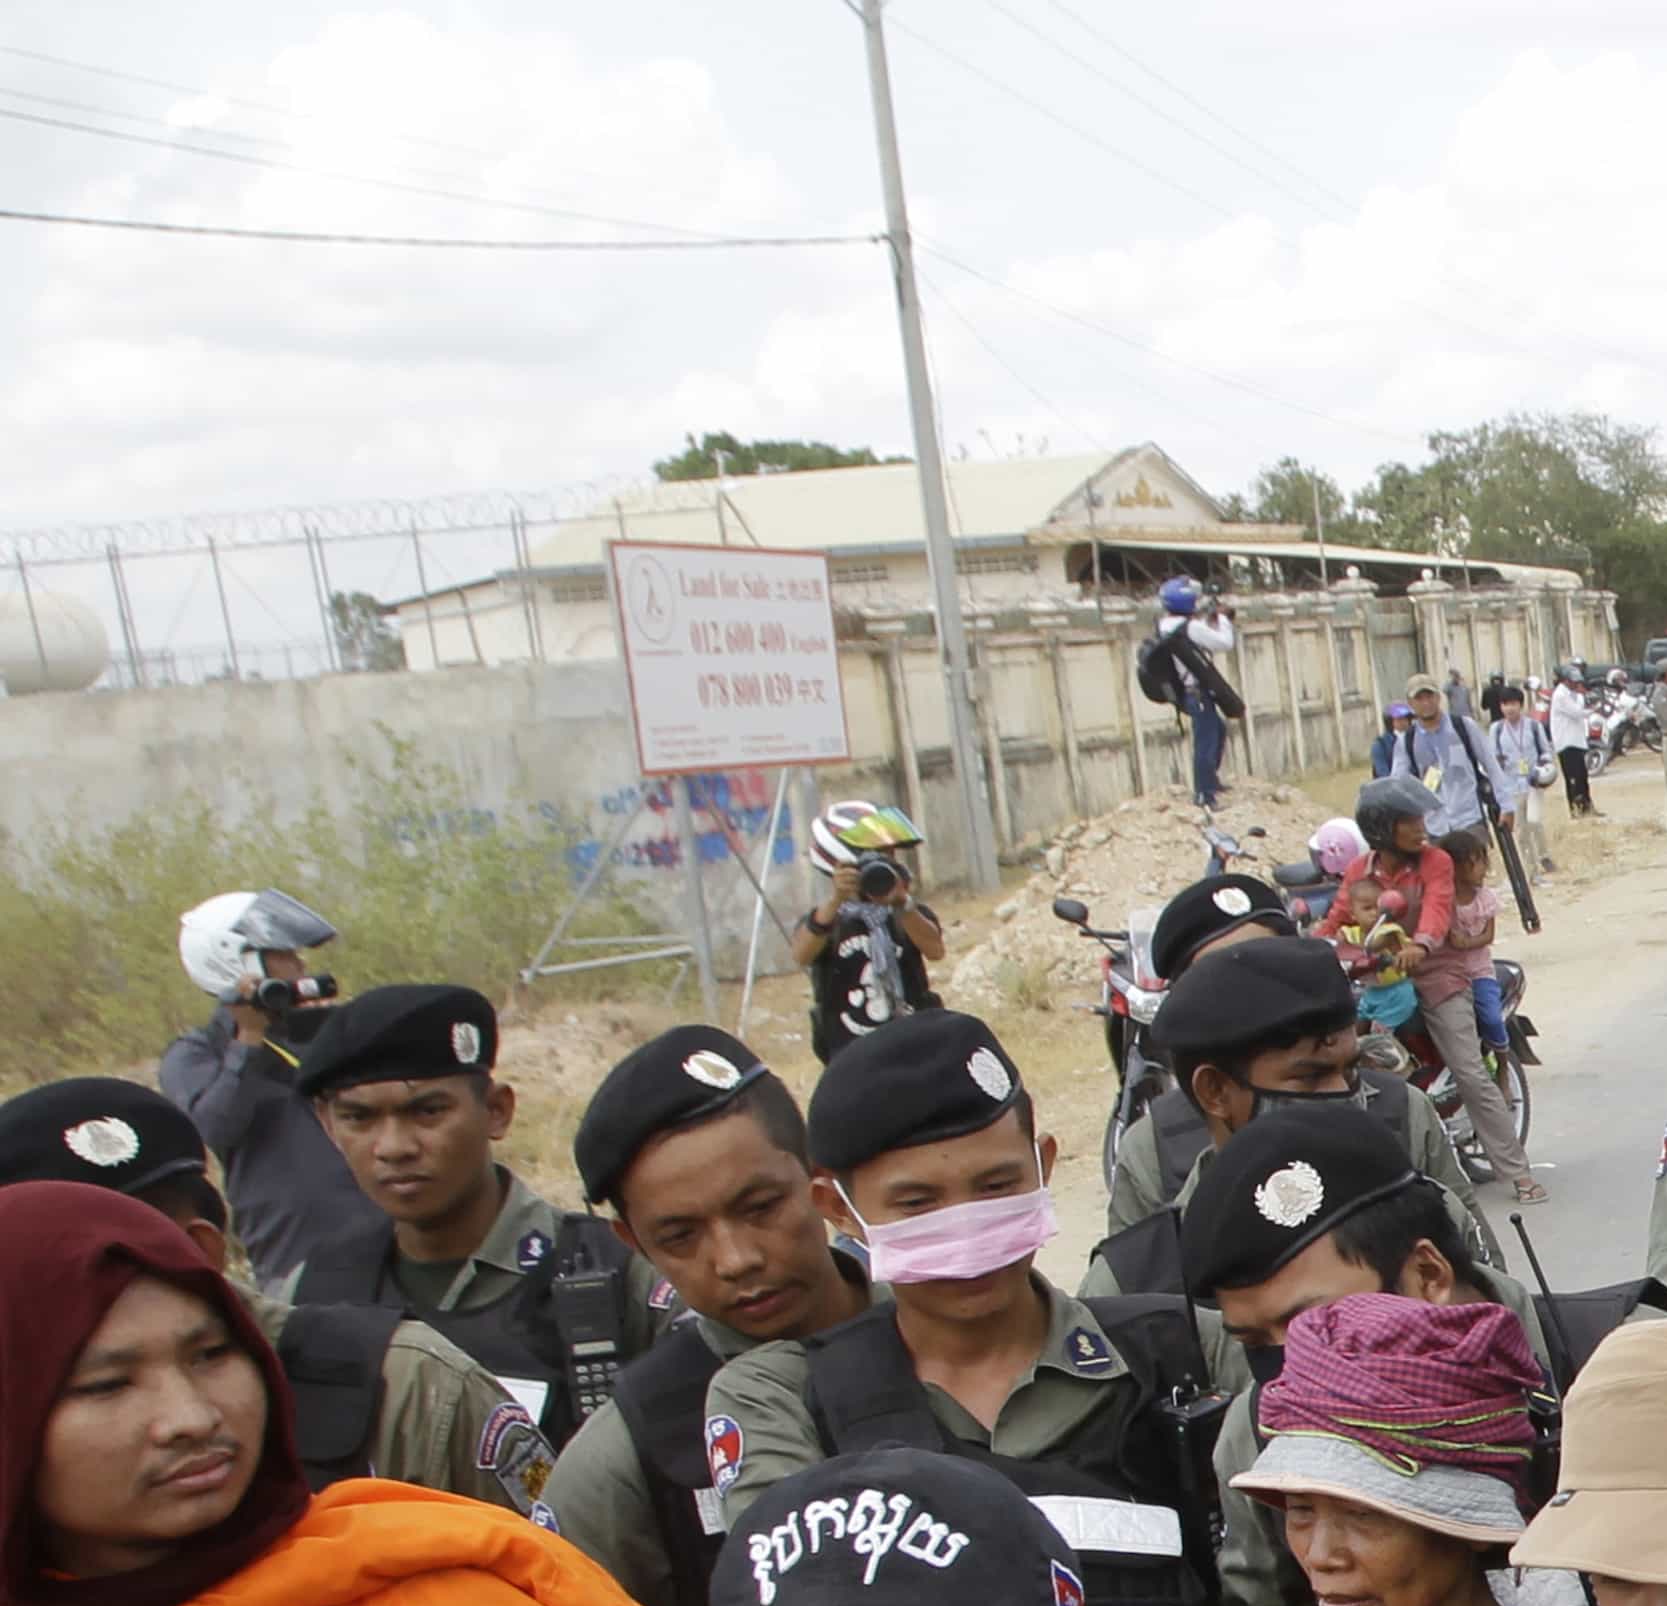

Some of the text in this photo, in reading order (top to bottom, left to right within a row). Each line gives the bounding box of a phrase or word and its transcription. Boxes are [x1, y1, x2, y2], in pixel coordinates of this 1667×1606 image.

[678, 568, 717, 598] Land
[719, 569, 740, 597] for
[741, 571, 769, 599] Sale
[690, 619, 722, 654] 012
[698, 672, 730, 708] 078
